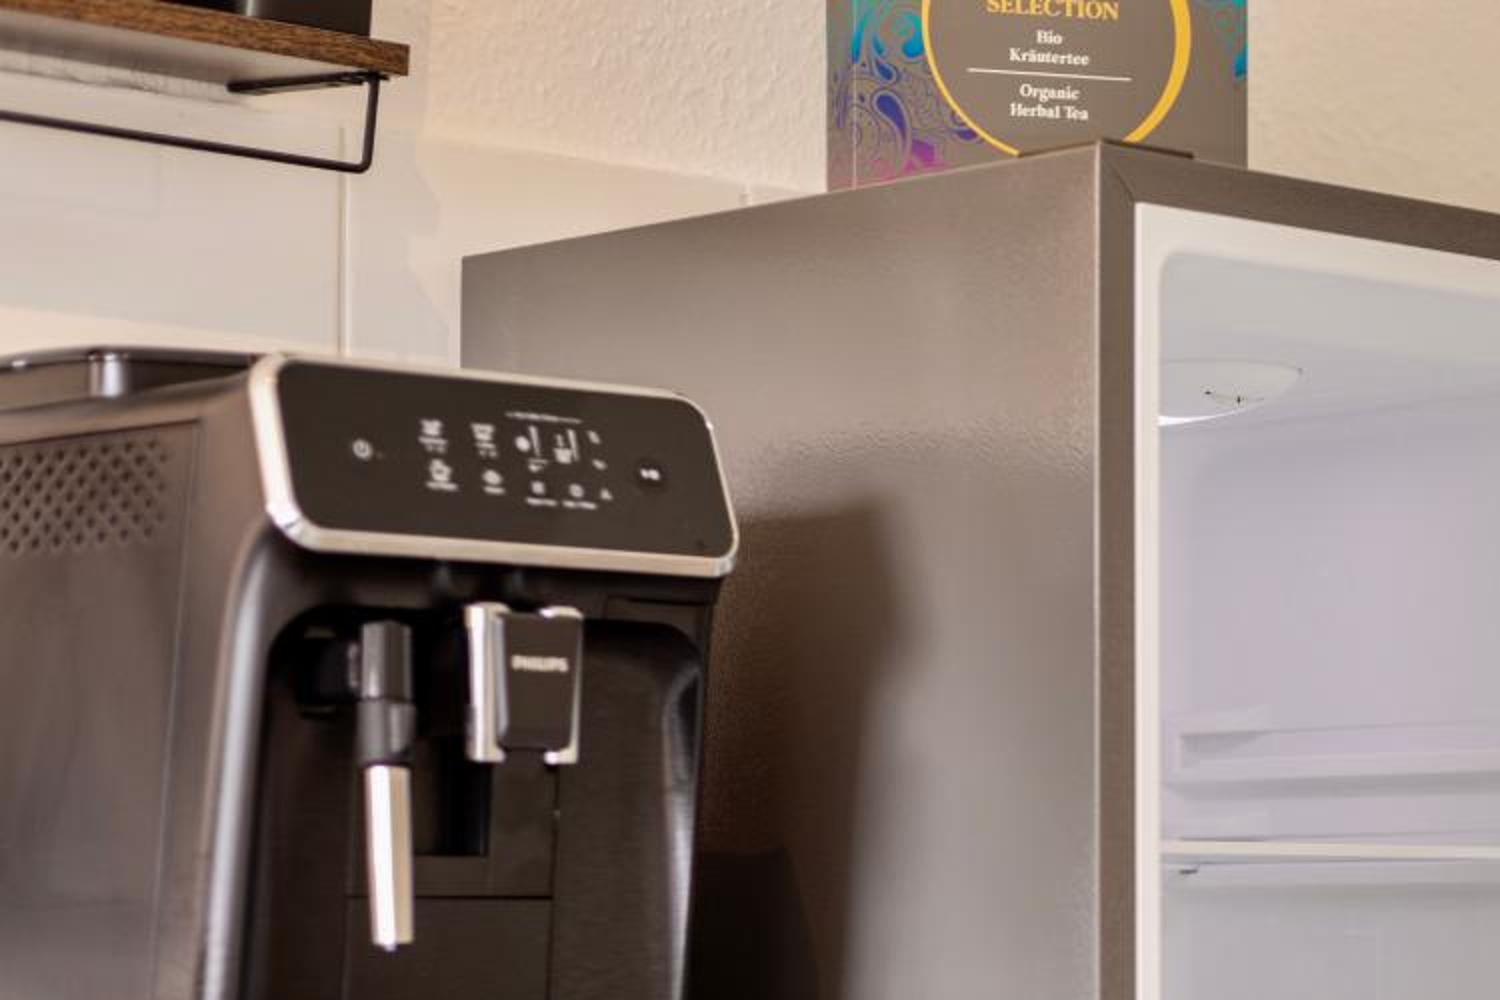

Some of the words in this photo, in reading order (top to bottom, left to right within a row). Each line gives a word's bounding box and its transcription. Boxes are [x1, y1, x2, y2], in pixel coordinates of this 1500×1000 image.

[986, 0, 1119, 20] SELECTION
[1036, 30, 1063, 44] Bio
[1009, 47, 1090, 66] Kräutertee
[1019, 83, 1080, 102] Organic
[1010, 102, 1060, 118] Herbal
[1064, 105, 1089, 120] Tea
